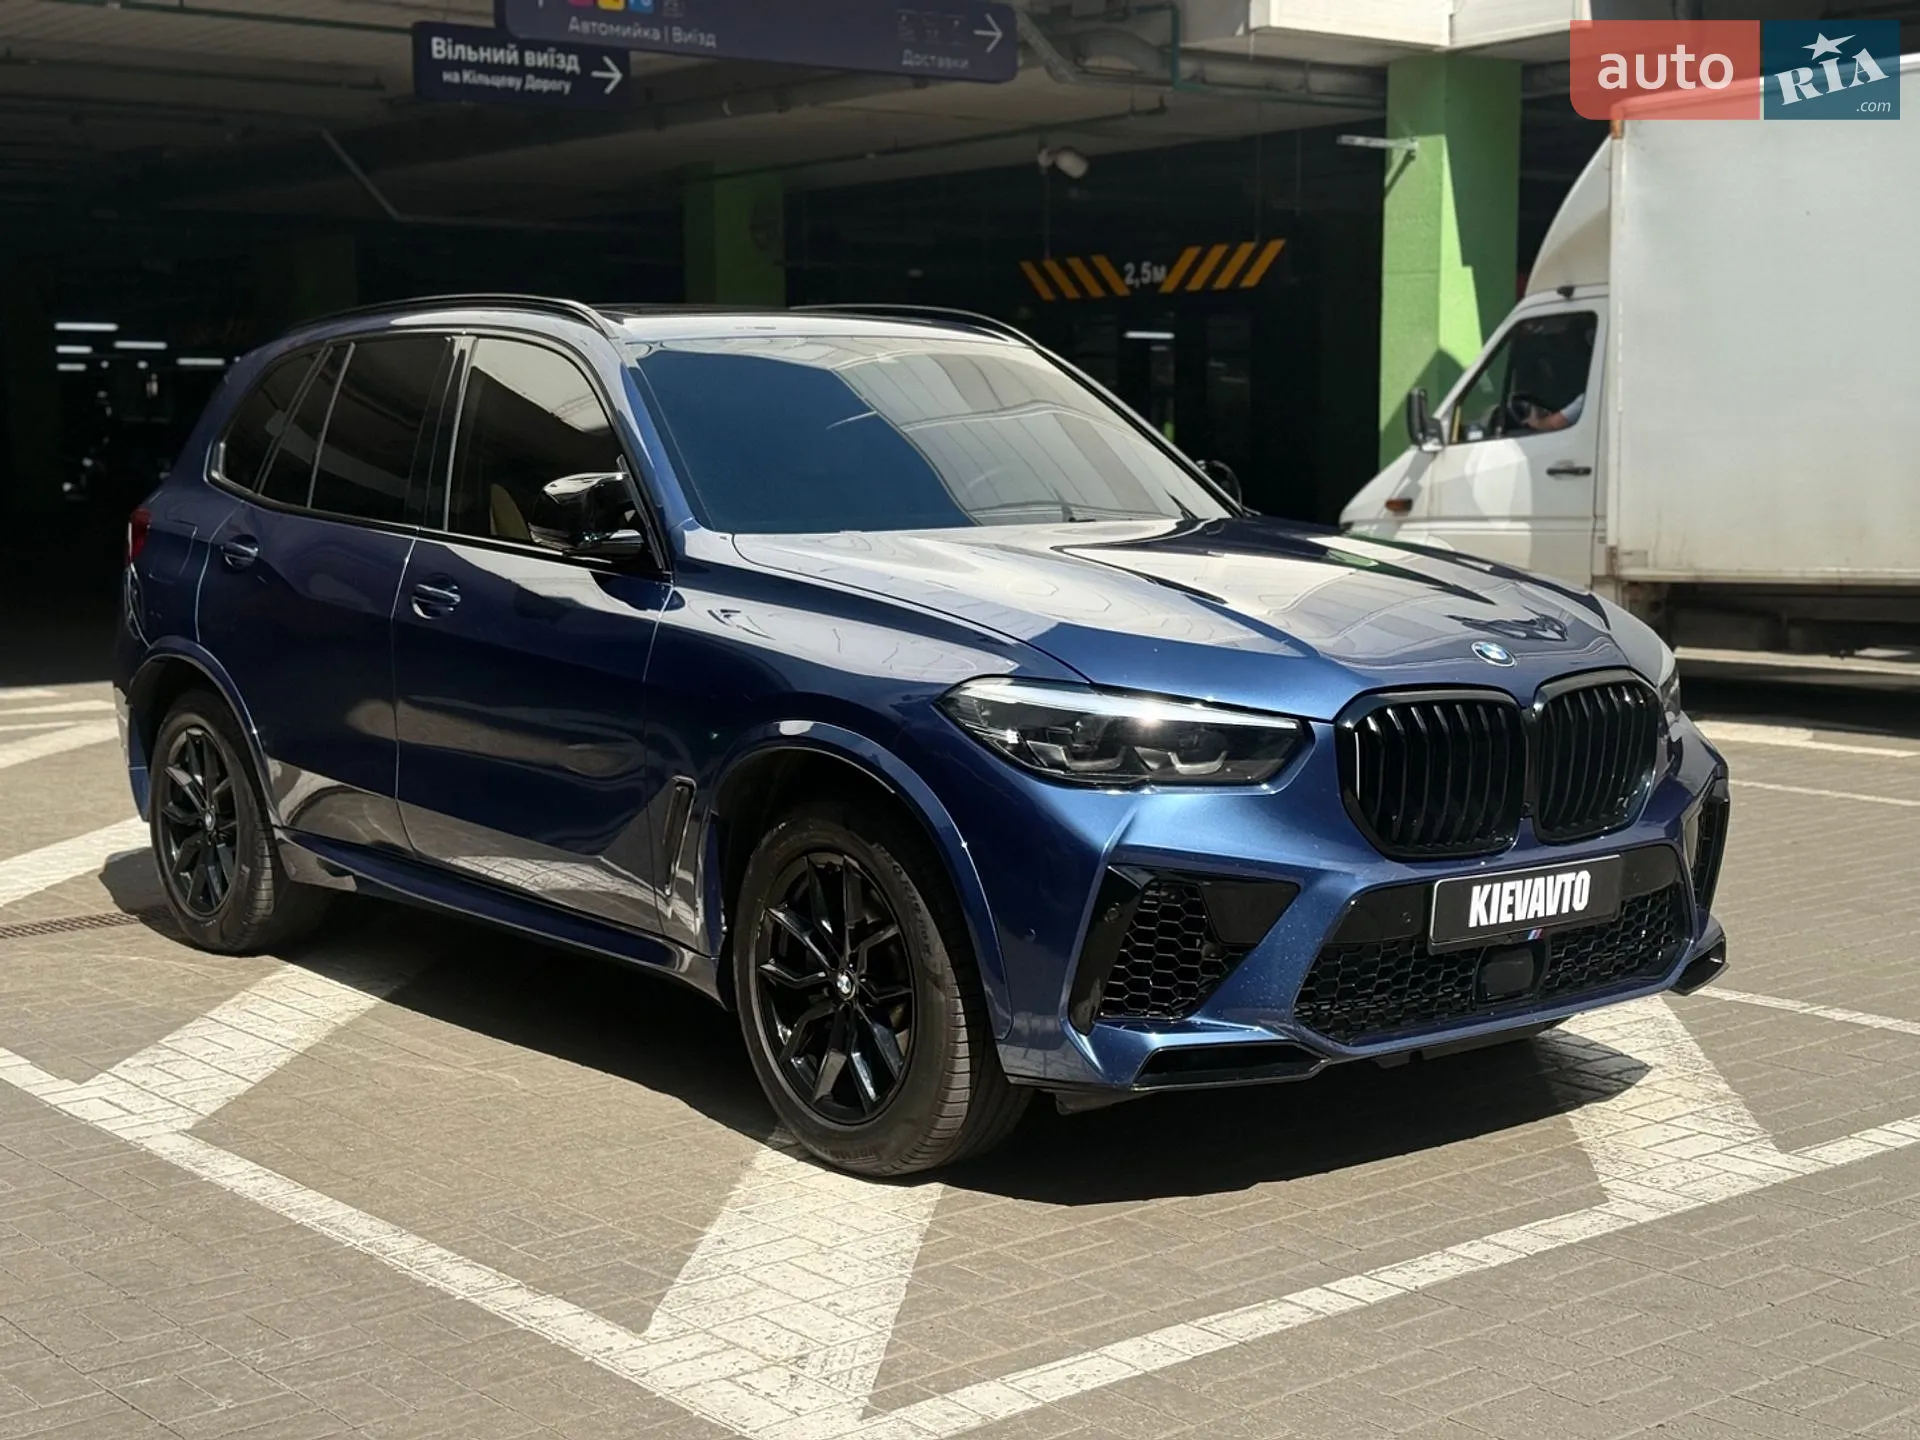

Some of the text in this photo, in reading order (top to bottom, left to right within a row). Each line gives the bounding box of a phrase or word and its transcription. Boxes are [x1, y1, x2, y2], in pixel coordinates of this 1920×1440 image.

[568, 16, 717, 48] Автомийка Виїзд
[431, 36, 581, 75] Вільний виїзд
[442, 69, 572, 95] на Кільцеву Дорогу
[1468, 870, 1592, 928] KIEVAVTO
